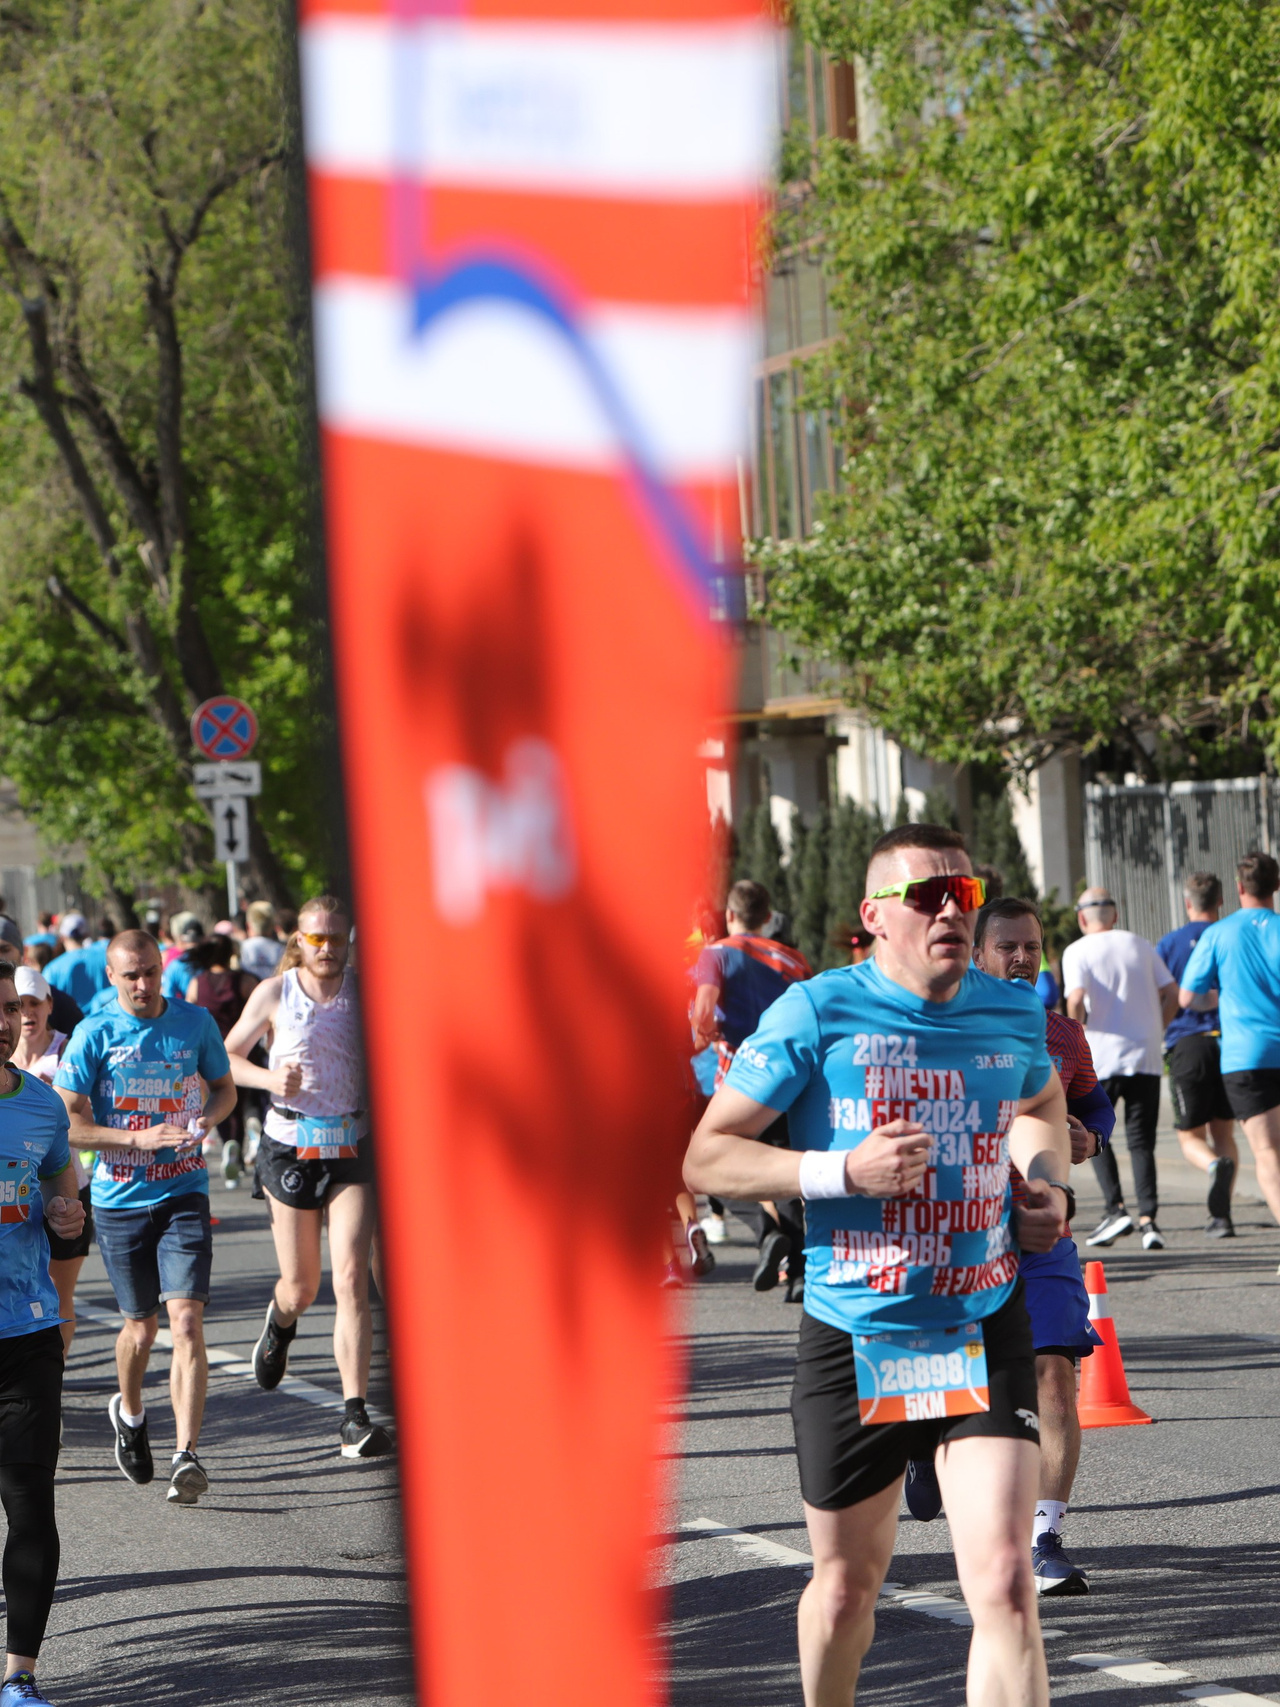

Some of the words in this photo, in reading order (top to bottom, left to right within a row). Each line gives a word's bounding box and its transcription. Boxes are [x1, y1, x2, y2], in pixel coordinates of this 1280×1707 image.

[852, 1033, 918, 1067] 2024
[127, 1078, 172, 1097] 22694
[864, 1067, 966, 1100] #МЕЧТА
[137, 1098, 161, 1112] 5KM
[312, 1127, 345, 1145] 21119
[319, 1145, 340, 1159] 5KM
[832, 1230, 953, 1267] #ЛЮБОВЬ
[880, 1352, 965, 1392] 26898
[903, 1390, 947, 1421] 5KM
